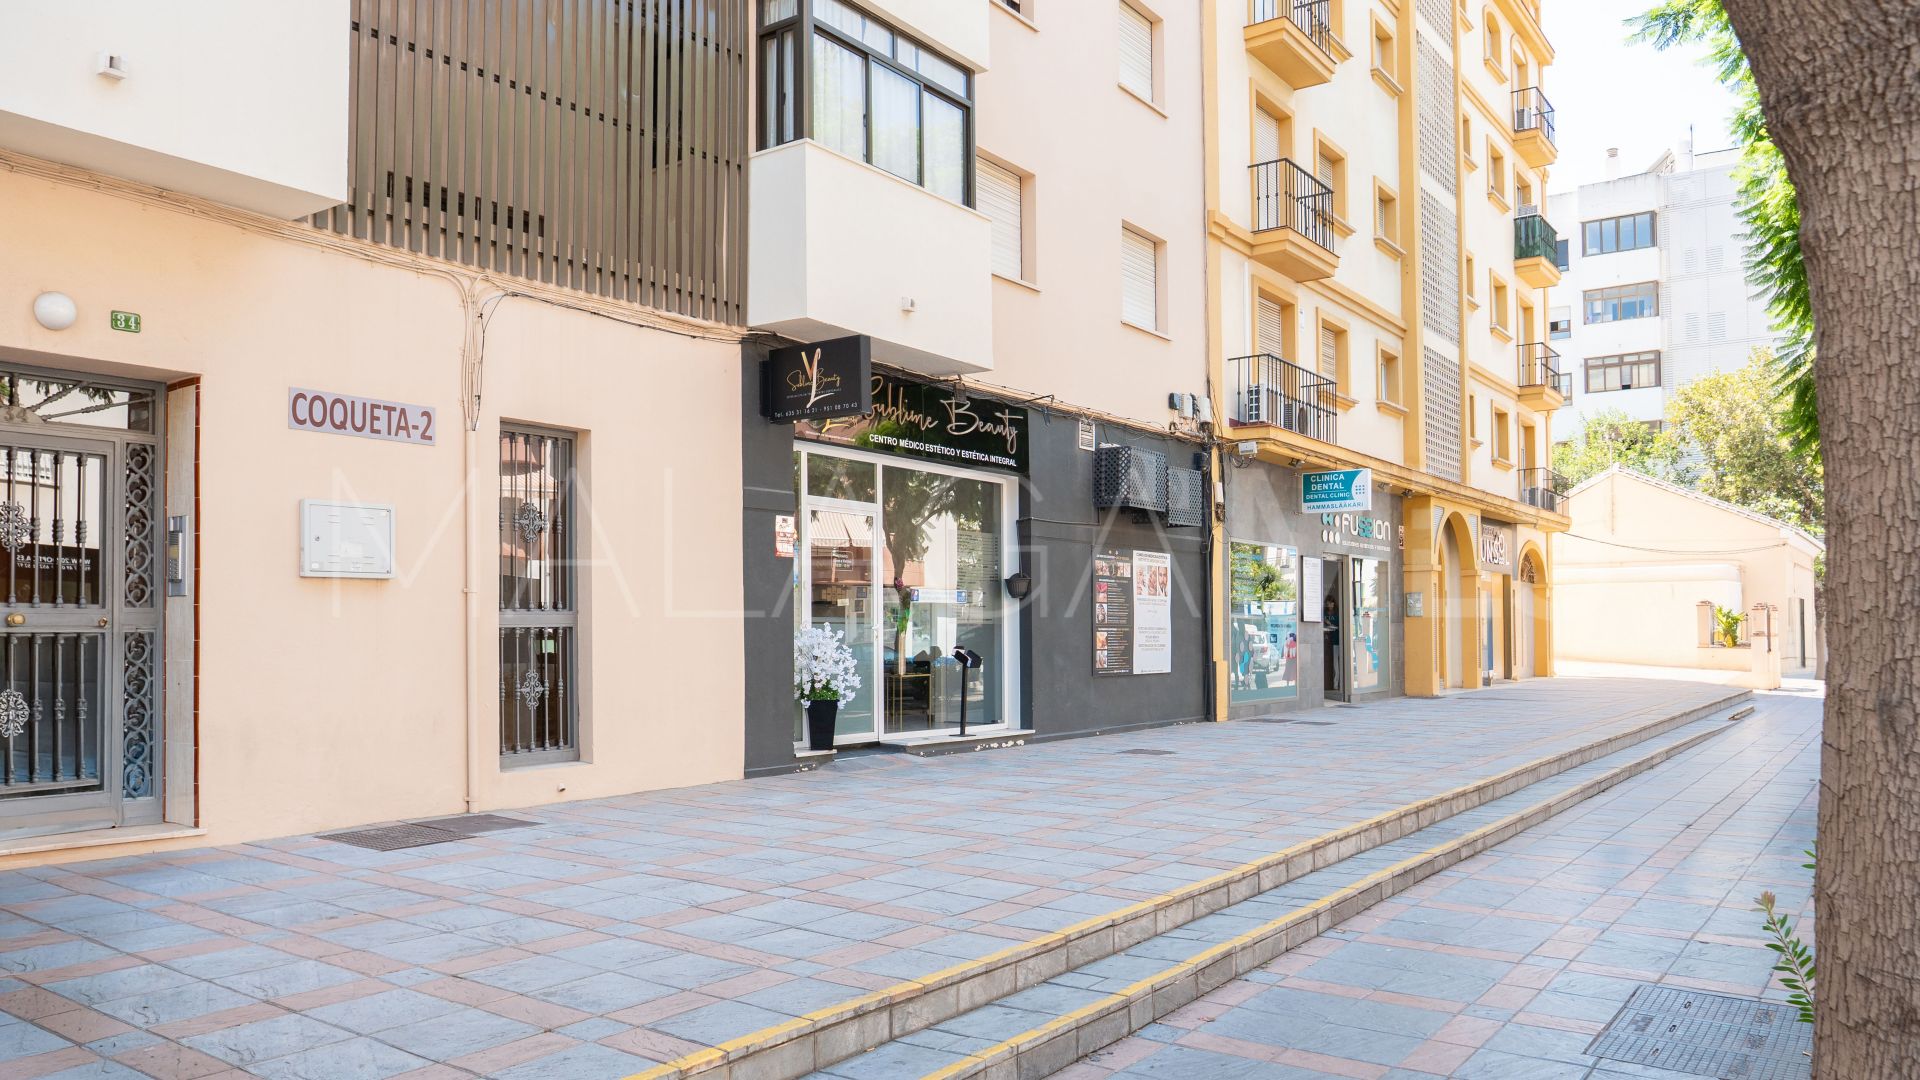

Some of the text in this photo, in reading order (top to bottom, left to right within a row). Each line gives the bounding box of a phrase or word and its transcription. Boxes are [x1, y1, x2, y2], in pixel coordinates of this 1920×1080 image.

[117, 313, 136, 330] 34
[291, 392, 433, 441] COQUETA-2
[939, 396, 1024, 455] Beauty
[869, 433, 898, 446] CENTRO
[899, 437, 925, 451] MÉDICO
[925, 443, 956, 456] ESTÉTICO
[956, 448, 961, 457] Y
[961, 449, 990, 462] ESTÉTICA
[989, 455, 1017, 467] INTEGRAL
[1310, 473, 1345, 483] CLINICA
[1311, 482, 1345, 491] DENTAL
